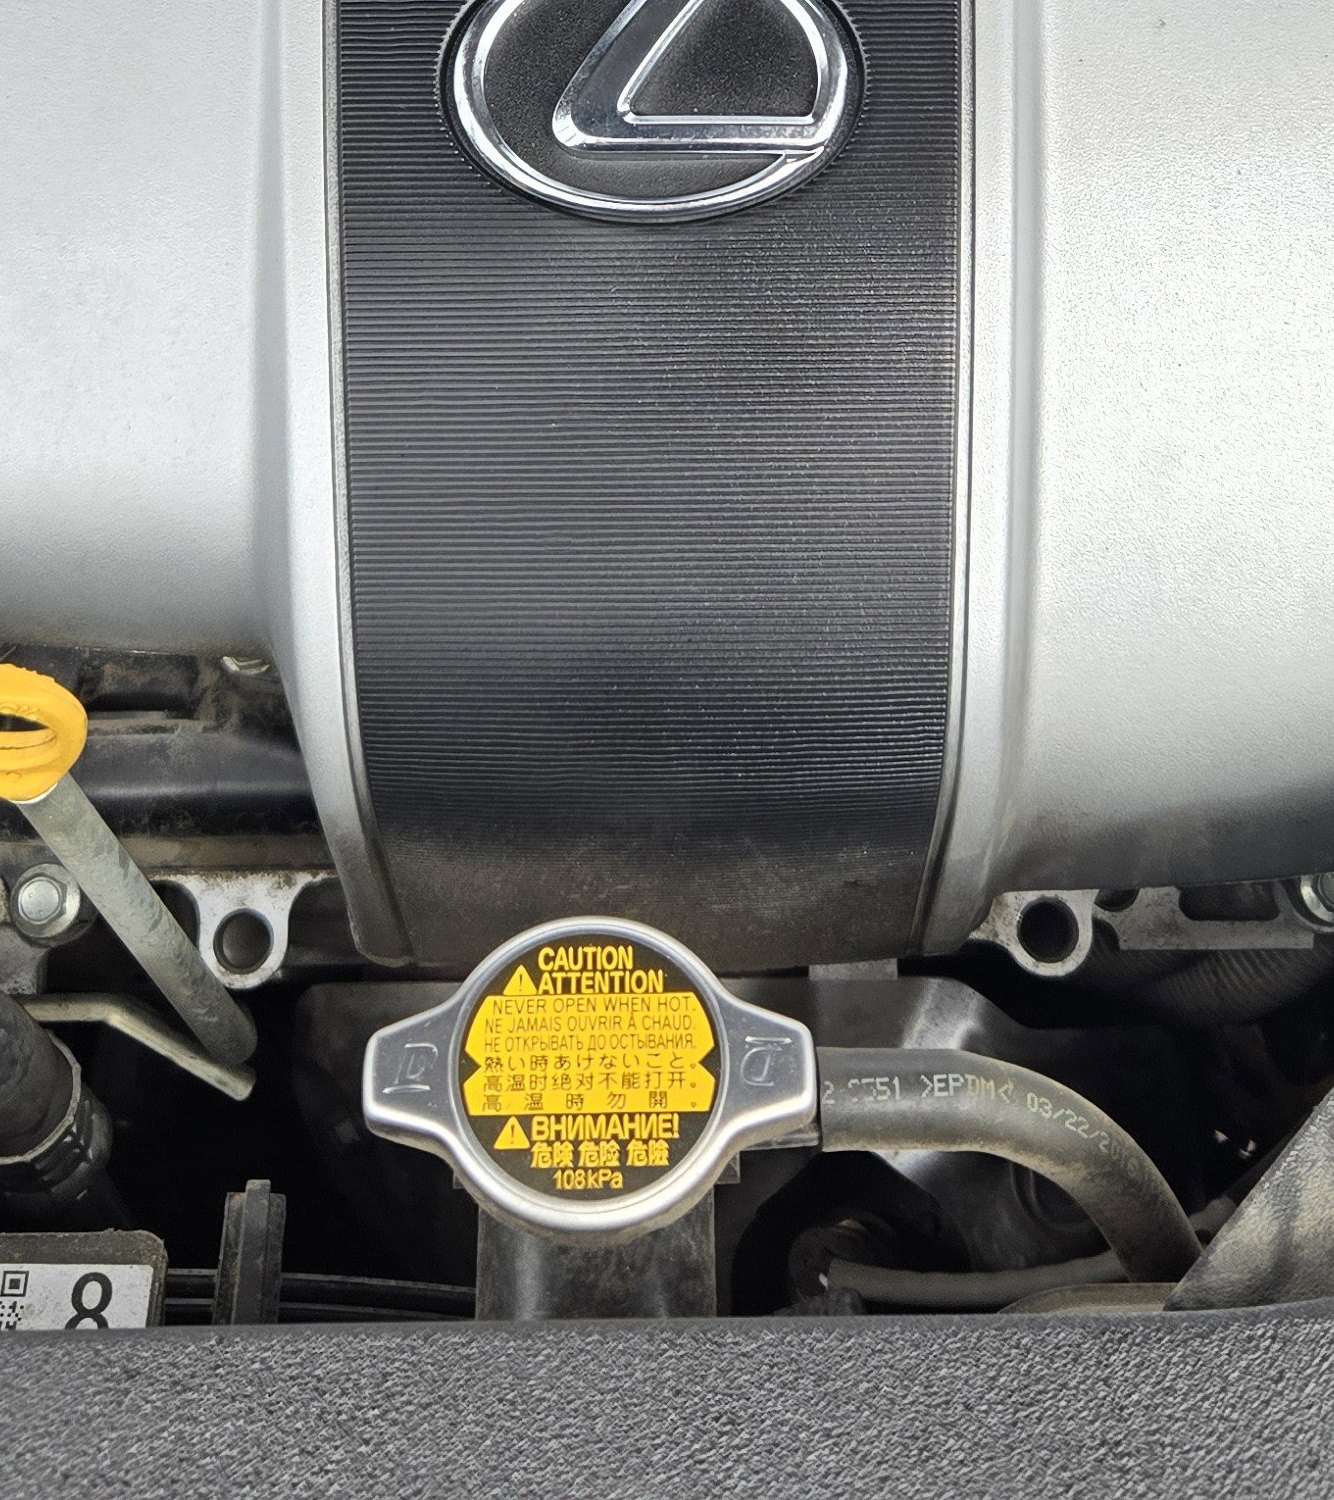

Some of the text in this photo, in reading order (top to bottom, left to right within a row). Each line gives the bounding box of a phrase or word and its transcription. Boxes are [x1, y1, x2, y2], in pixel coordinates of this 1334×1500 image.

[538, 945, 634, 971] CAUTION
[538, 969, 664, 995] ATTENTION
[492, 995, 696, 1015] NEVER OPEN WHEN HOT.
[485, 1012, 696, 1034] NE JAMAIS OUVRIR À CHAUD.
[484, 1033, 696, 1053] НЕ ОТКРЫВАТЬ ДО ОСТЫВАНИЯ.
[484, 1052, 696, 1073] 熱い時あけないこと。
[483, 1071, 696, 1092] 高温时绝对不能打开。
[530, 1112, 680, 1141] ВНИМАНИЕ!
[553, 1168, 624, 1190] 108kPa
